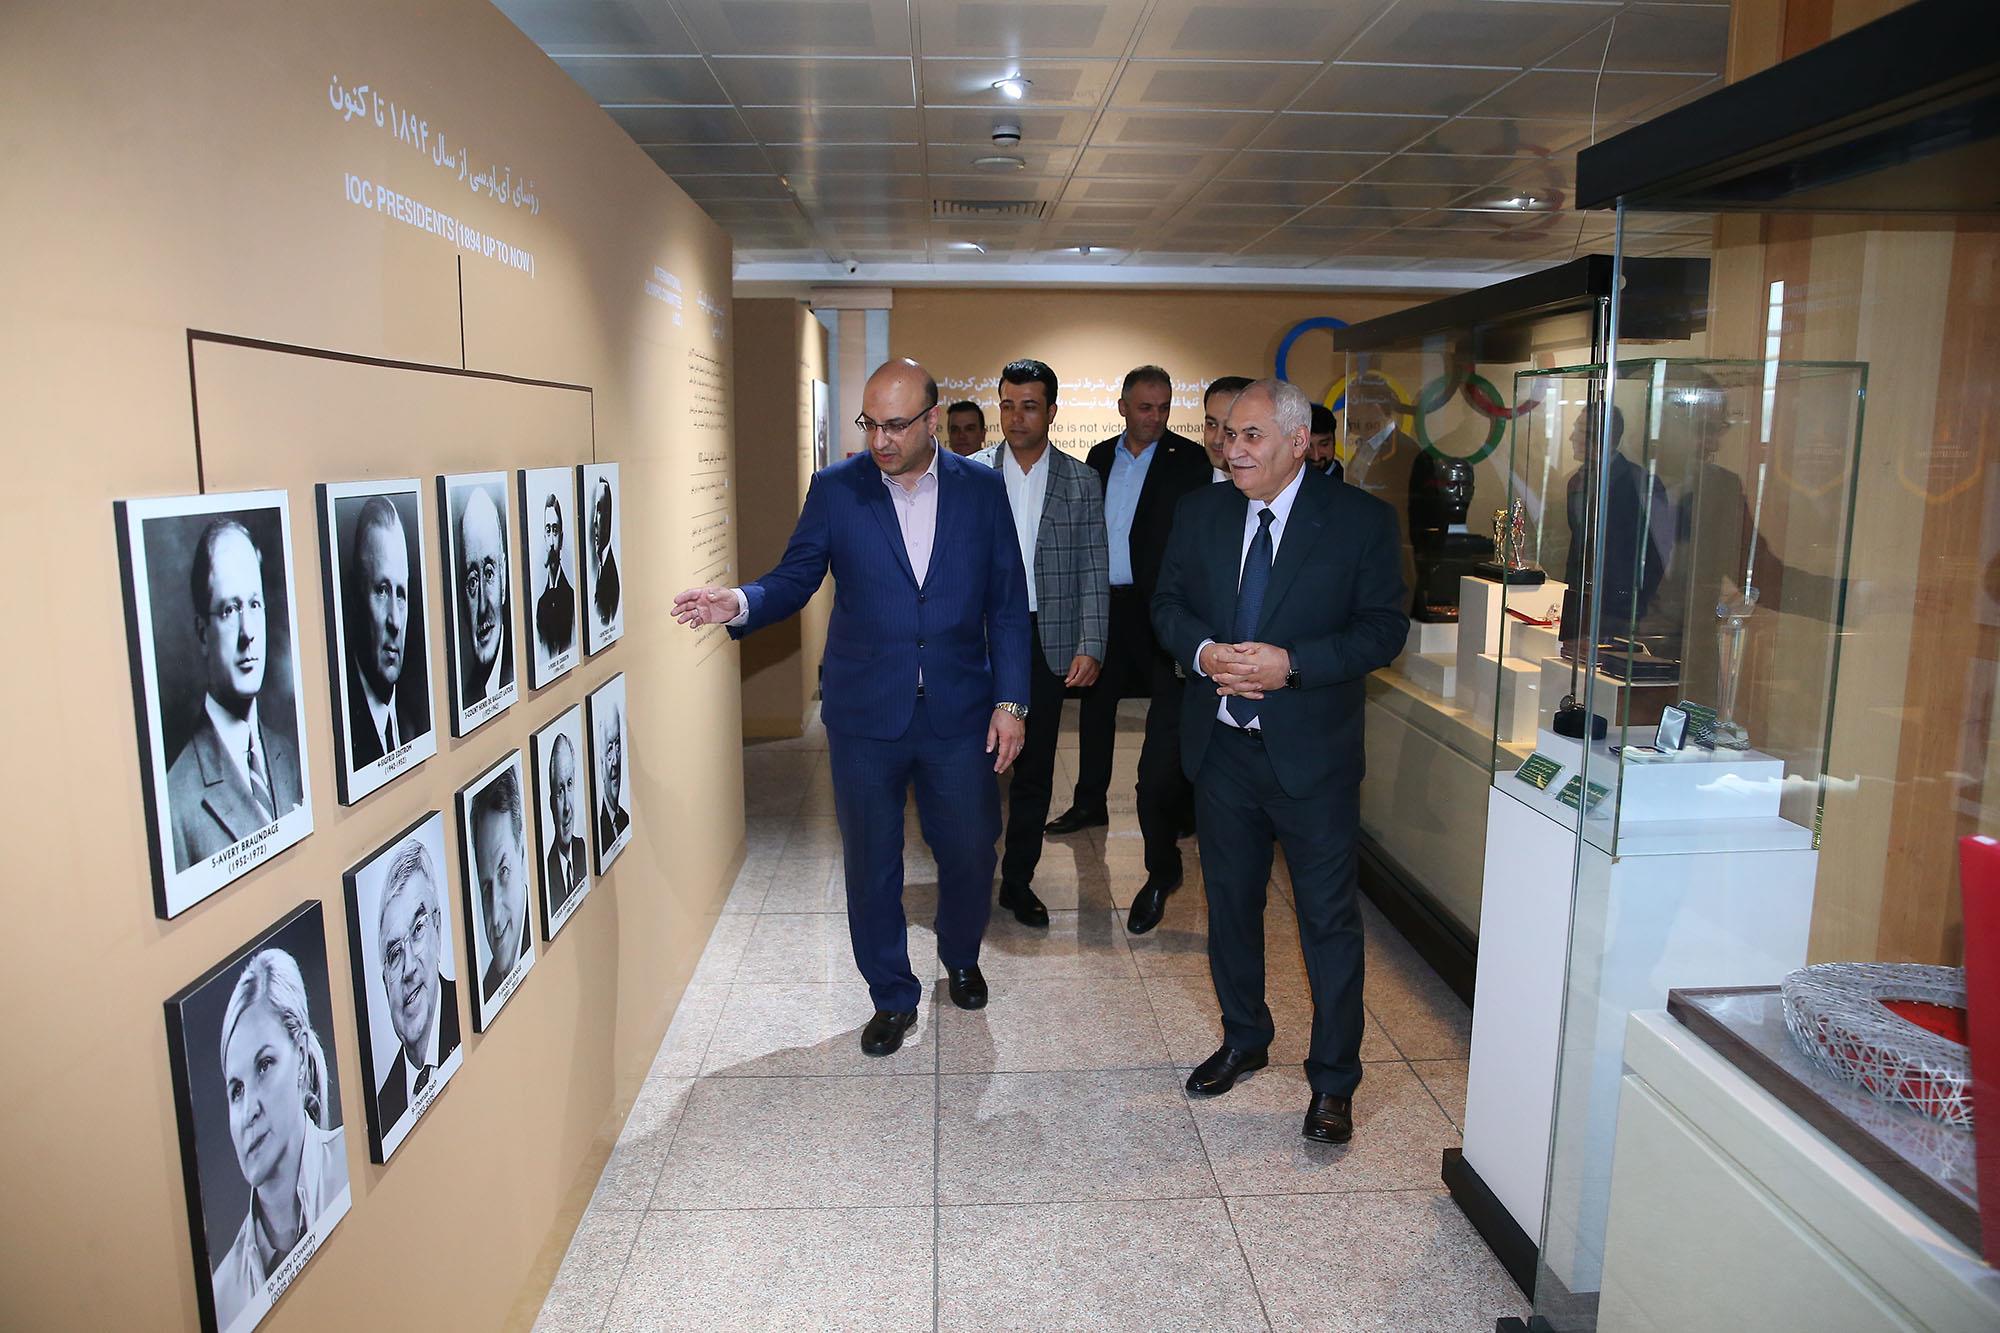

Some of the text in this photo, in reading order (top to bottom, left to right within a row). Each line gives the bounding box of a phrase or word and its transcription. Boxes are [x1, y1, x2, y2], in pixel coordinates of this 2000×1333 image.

[329, 74, 369, 122] کنون
[373, 91, 385, 128] تا
[432, 132, 456, 169] سال
[458, 147, 468, 181] از
[345, 172, 373, 209] IOC
[482, 234, 496, 259] UP
[495, 240, 509, 265] TO
[1067, 422, 1078, 433] is
[1079, 423, 1099, 433] not
[211, 822, 279, 869] 5-AVERY BRAUNDAGE
[228, 844, 267, 875] (1952-1972)
[276, 1262, 293, 1284] Kirsty
[292, 1232, 317, 1263] Coventry
